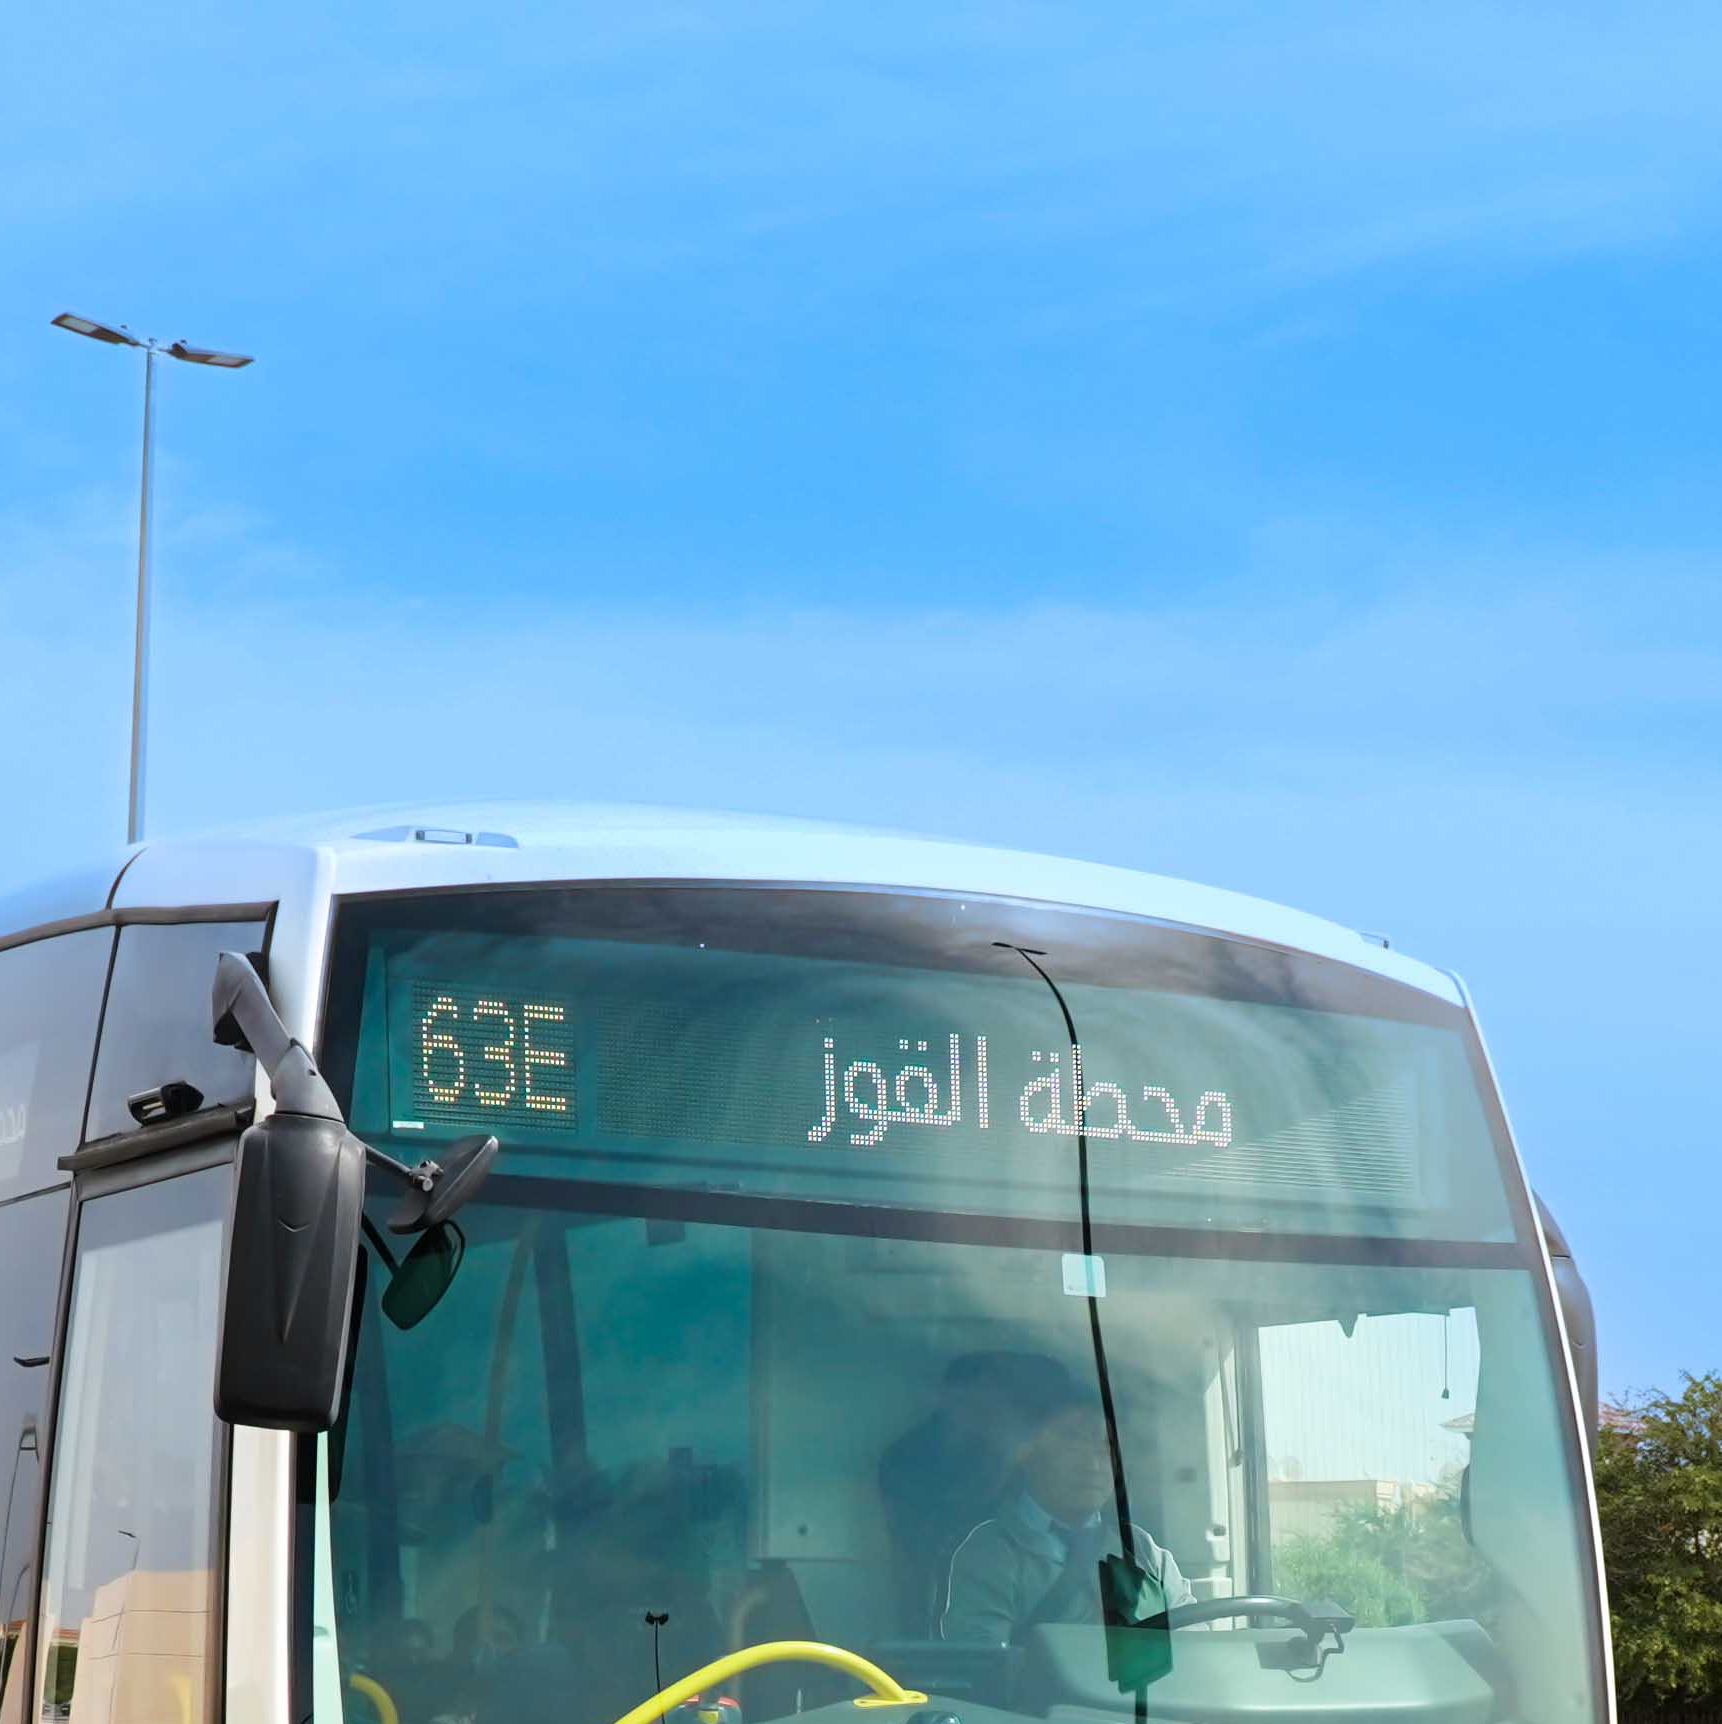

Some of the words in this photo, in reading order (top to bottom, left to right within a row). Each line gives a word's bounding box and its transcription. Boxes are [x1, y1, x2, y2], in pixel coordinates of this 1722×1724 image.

[421, 997, 566, 1111] 63E
[807, 1033, 990, 1146] القوز
[1020, 1043, 1233, 1147] محطة
